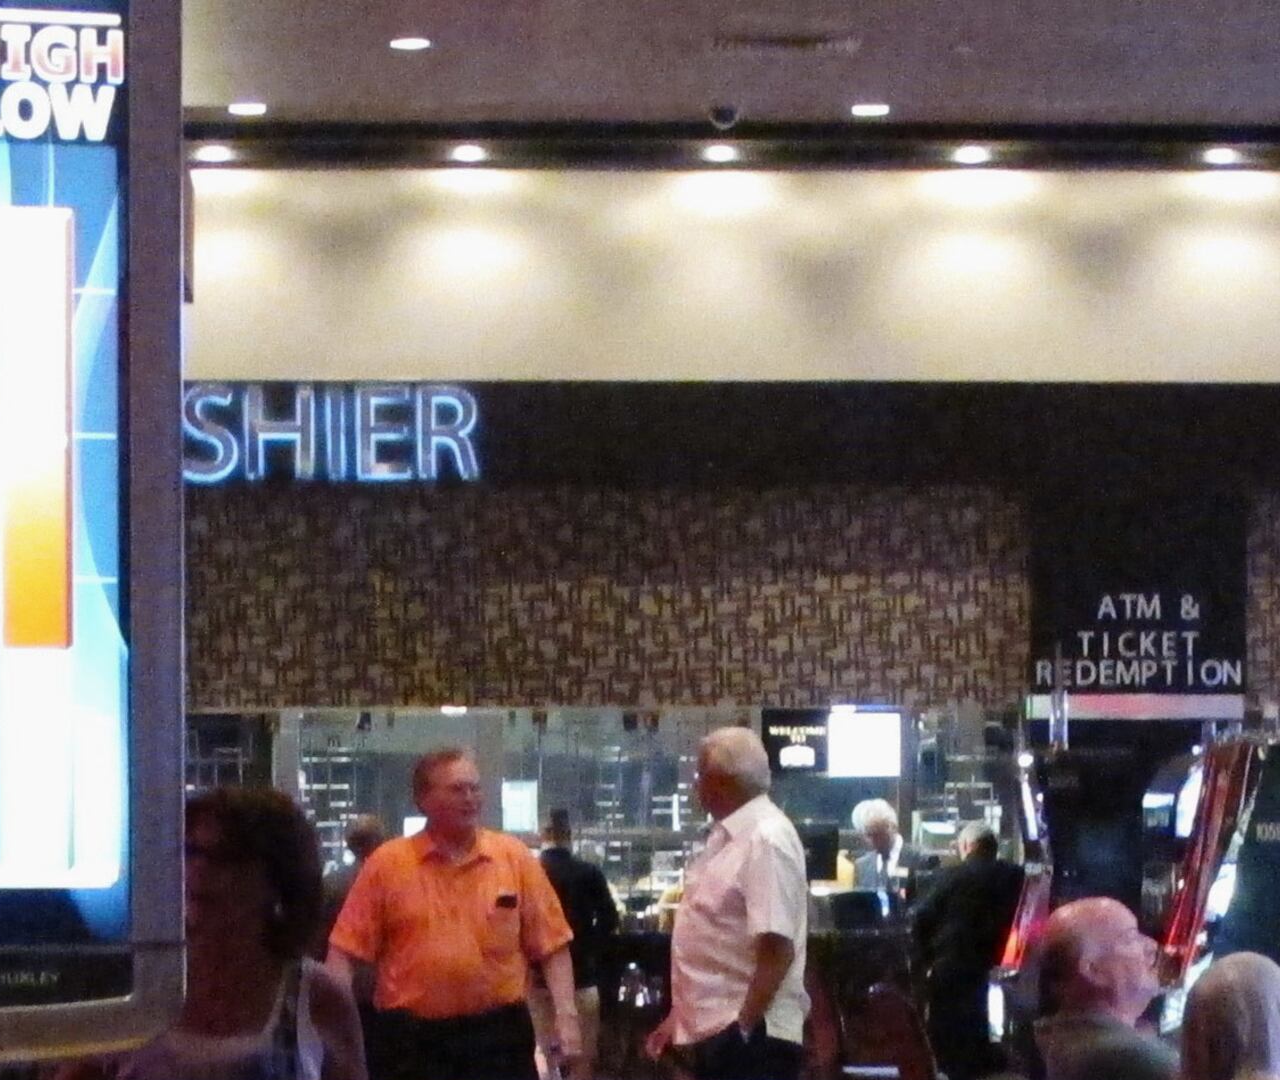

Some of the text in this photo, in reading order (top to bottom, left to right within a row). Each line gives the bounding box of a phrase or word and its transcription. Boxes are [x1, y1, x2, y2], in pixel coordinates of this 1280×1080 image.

[182, 384, 479, 482] SHIER
[1097, 594, 1200, 620] ATM &
[1077, 631, 1200, 658] TICKET
[1036, 659, 1242, 686] REDEMPTION
